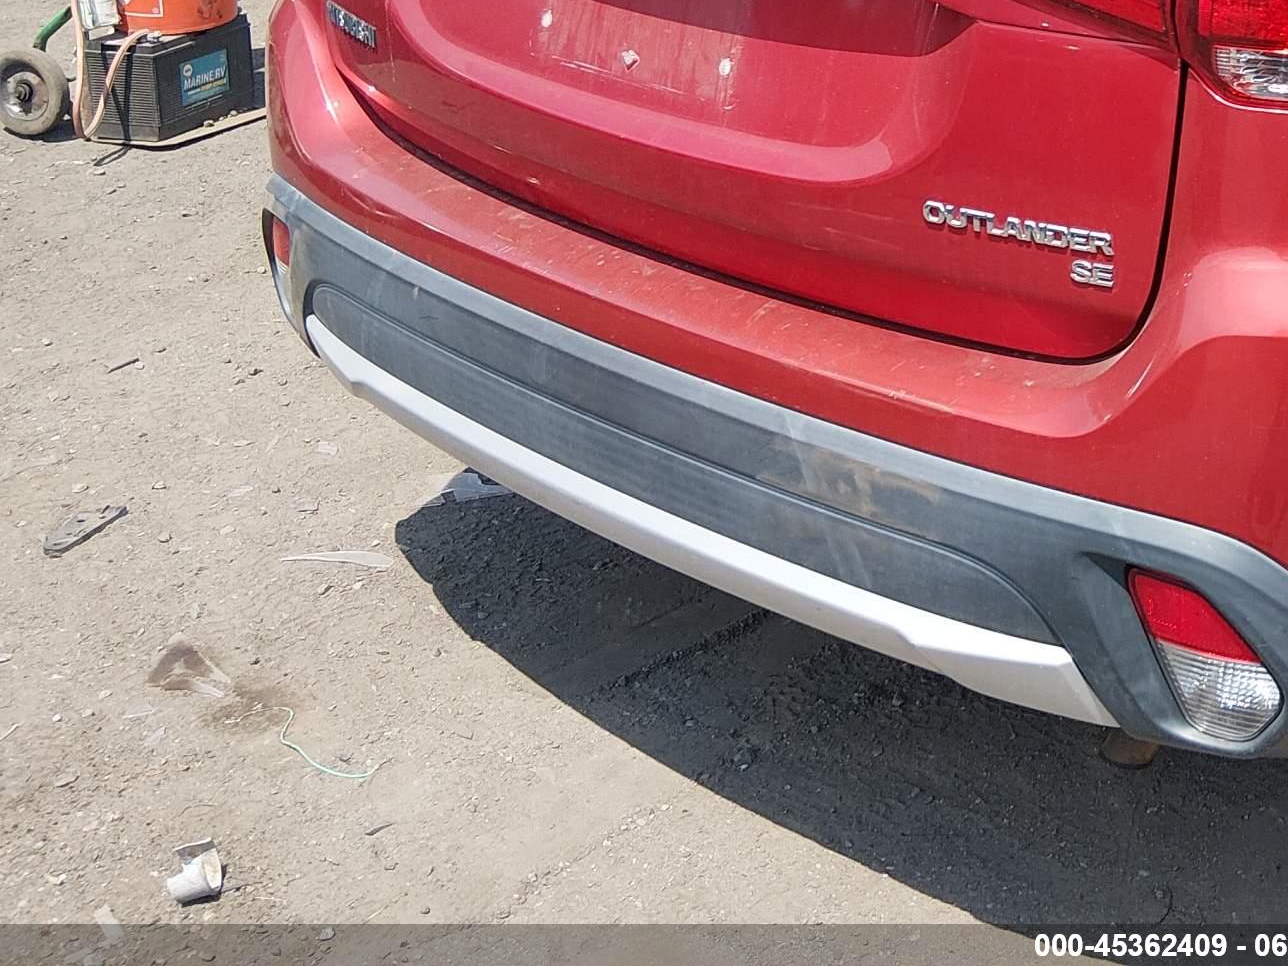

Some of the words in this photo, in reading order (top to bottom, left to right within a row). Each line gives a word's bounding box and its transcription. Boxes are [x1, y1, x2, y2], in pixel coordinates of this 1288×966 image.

[184, 70, 214, 91] MARINE
[215, 66, 226, 78] RV
[923, 200, 1115, 256] OUTLANDER
[1070, 259, 1115, 288] SE
